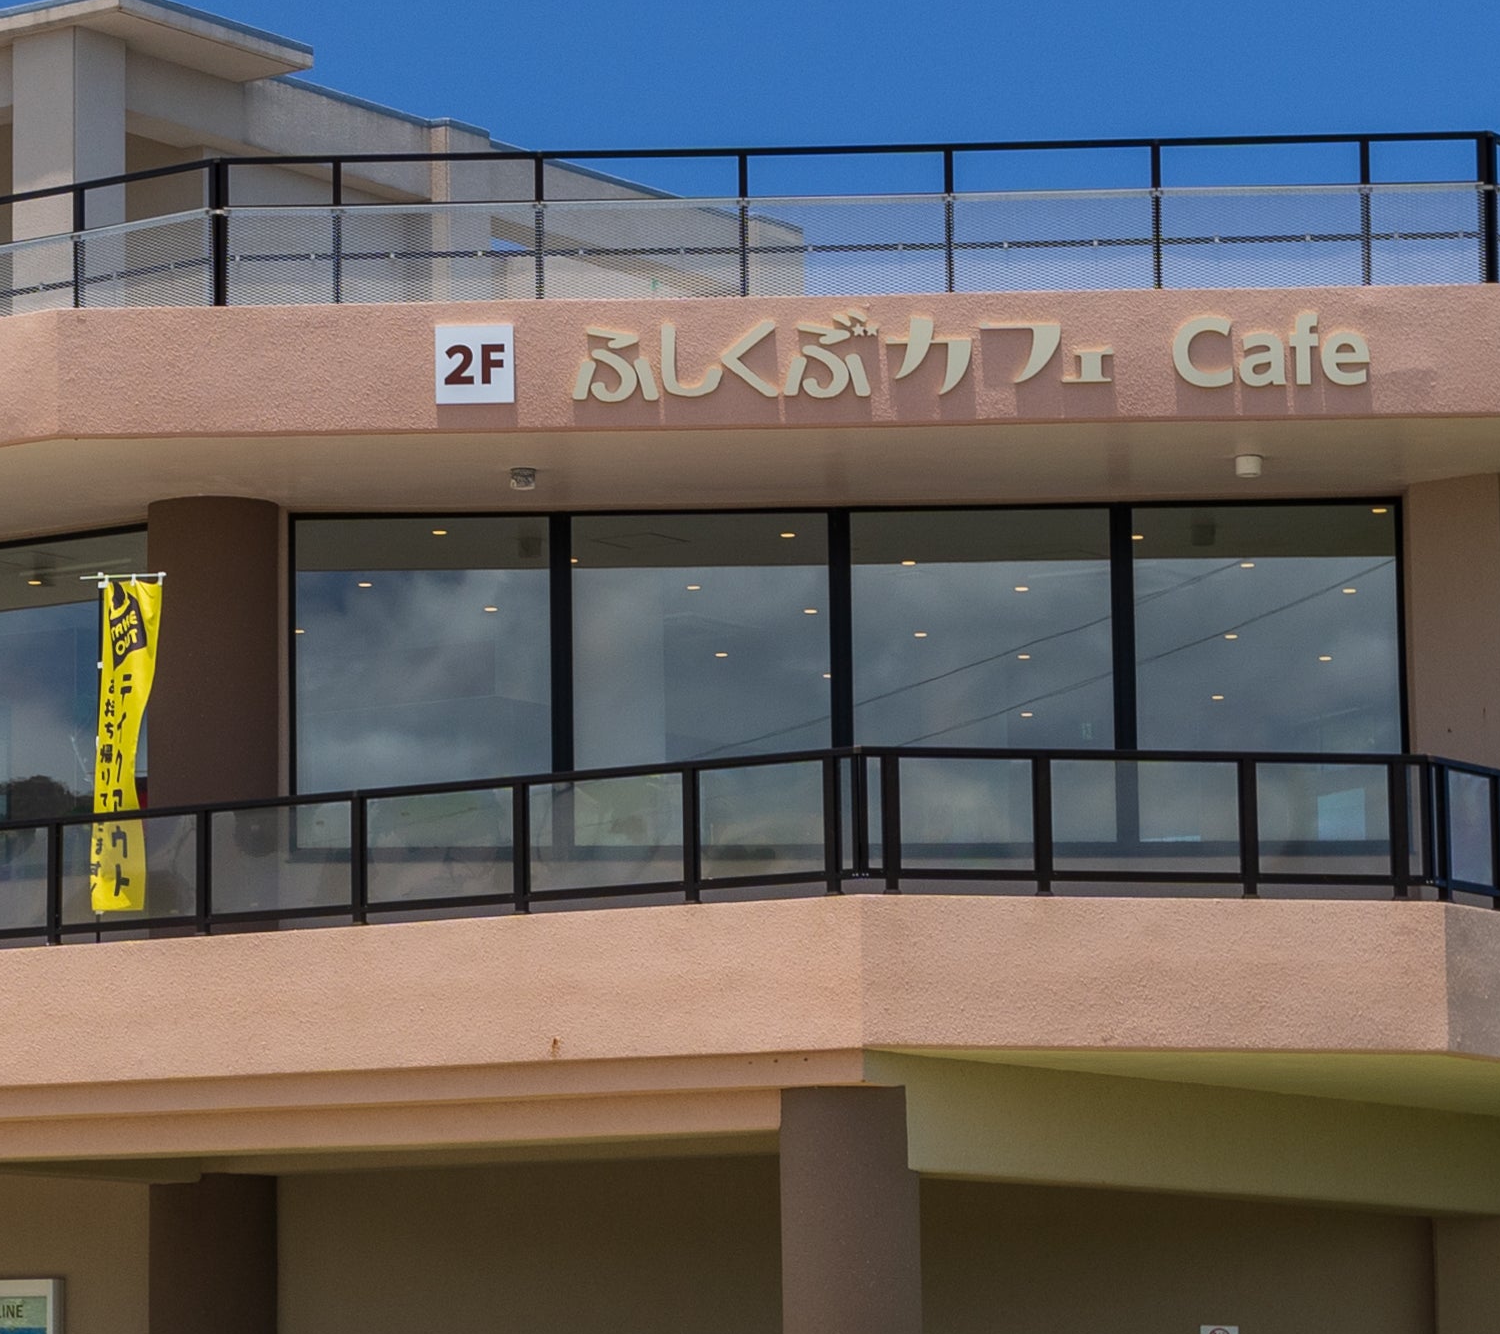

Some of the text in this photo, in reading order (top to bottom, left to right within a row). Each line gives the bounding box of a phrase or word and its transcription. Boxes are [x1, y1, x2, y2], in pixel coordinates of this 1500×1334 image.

[442, 343, 506, 386] 2F
[572, 308, 1371, 401] ふしくぶカフェ Cafe
[115, 628, 139, 657] OUT
